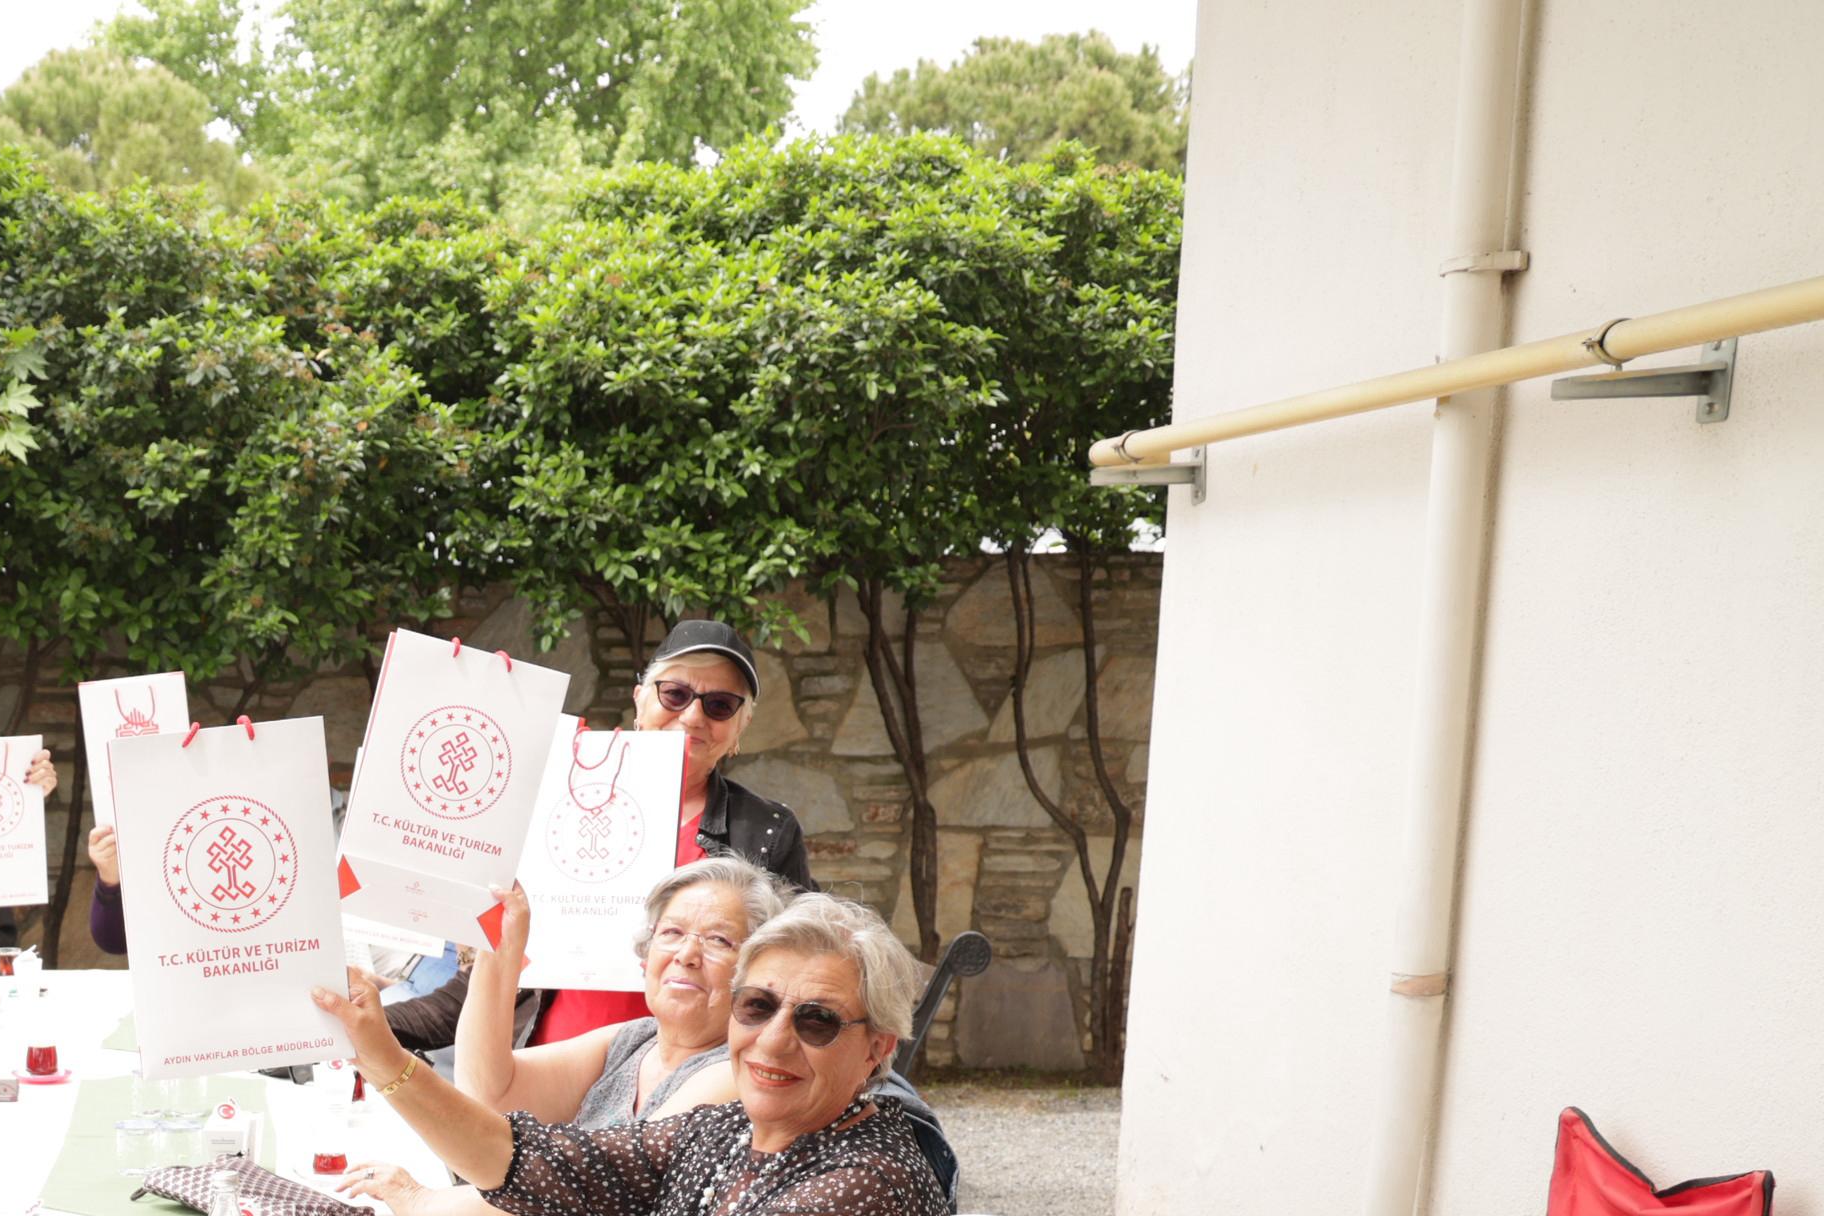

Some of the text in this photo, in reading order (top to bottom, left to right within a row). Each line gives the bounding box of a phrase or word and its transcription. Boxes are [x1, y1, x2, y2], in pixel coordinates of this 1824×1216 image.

[393, 818, 439, 839] KÜLTÜR
[441, 831, 456, 844] VE
[459, 835, 503, 857] TURİZM
[402, 835, 465, 860] BAKANLIĞI
[158, 938, 320, 967] T.C. KÜLTÜR VE TURİZM
[203, 957, 279, 978] BAKANLIĞI
[163, 1037, 334, 1066] AYDIN VAKIFLAR BÖLGE MÜDÜRLÜĞÜ
